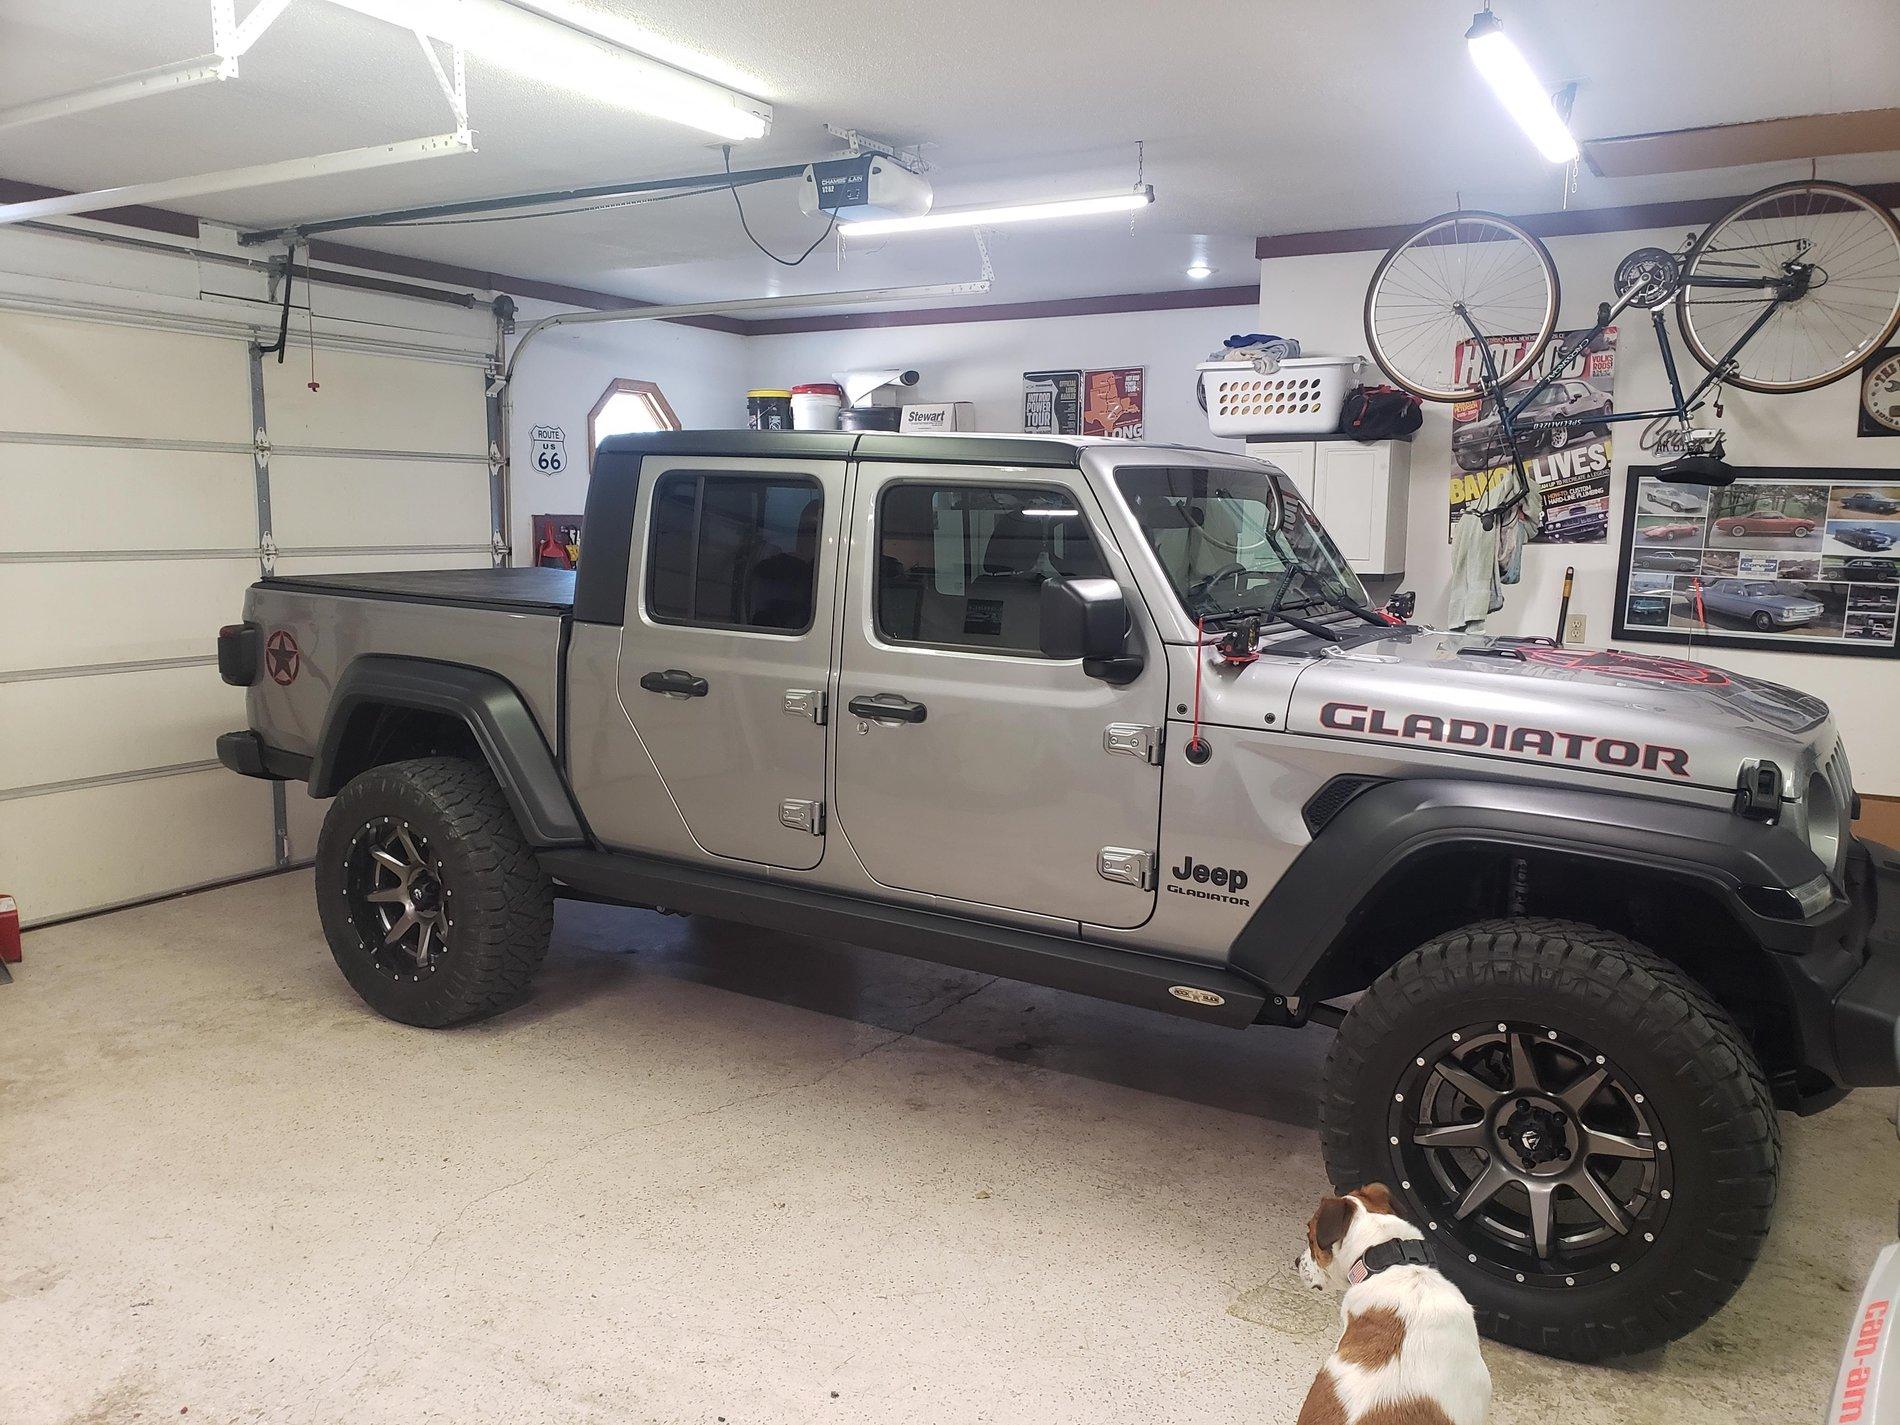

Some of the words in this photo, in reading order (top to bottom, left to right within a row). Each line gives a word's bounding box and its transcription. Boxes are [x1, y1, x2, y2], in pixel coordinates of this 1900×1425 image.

[1458, 342, 1518, 385] HOT
[1521, 339, 1586, 381] ROD
[1026, 401, 1050, 413] POWER
[908, 410, 945, 422] Stewart
[1026, 411, 1050, 427] TOUR
[1533, 418, 1582, 430] SPECIALIZED
[538, 430, 560, 439] ROUTE
[538, 452, 561, 470] 66
[1532, 439, 1613, 484] LIVES!
[1569, 485, 1592, 494] CUSTOM
[1576, 487, 1605, 499] PLUMBING
[1743, 561, 1775, 569] Corvair
[1319, 701, 1691, 778] GLADIATOR
[1172, 855, 1248, 894] Jeep
[1167, 884, 1250, 907] GLADIATOR
[1839, 1298, 1890, 1424] can-am
